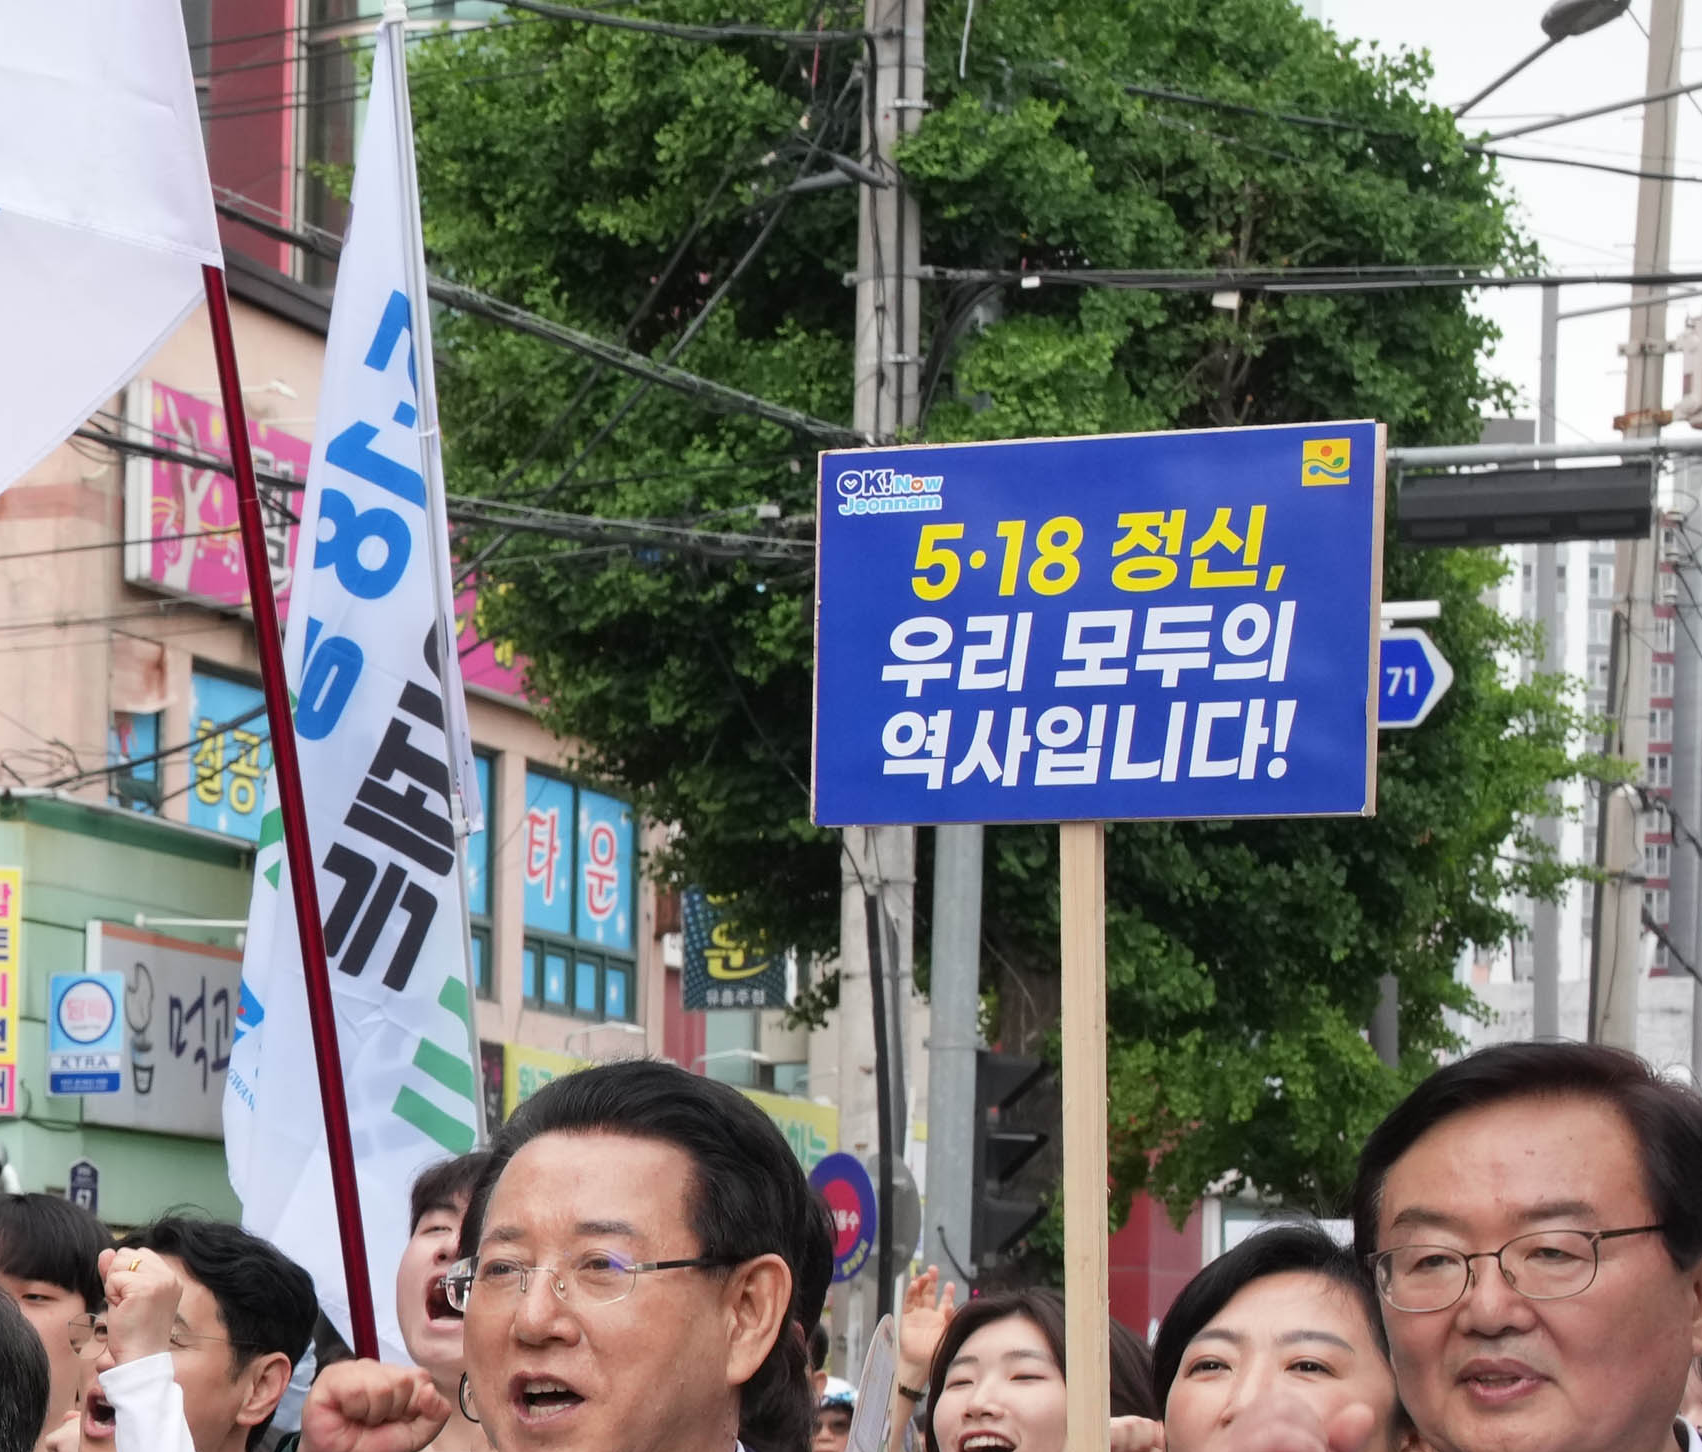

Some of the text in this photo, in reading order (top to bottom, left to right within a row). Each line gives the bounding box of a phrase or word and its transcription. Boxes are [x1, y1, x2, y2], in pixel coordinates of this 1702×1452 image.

[838, 494, 942, 516] Jeonnam
[1109, 504, 1287, 592] 정신,
[881, 601, 1297, 698] 우리 모두의
[1386, 667, 1417, 696] 71
[881, 699, 1298, 790] 역사입니다!
